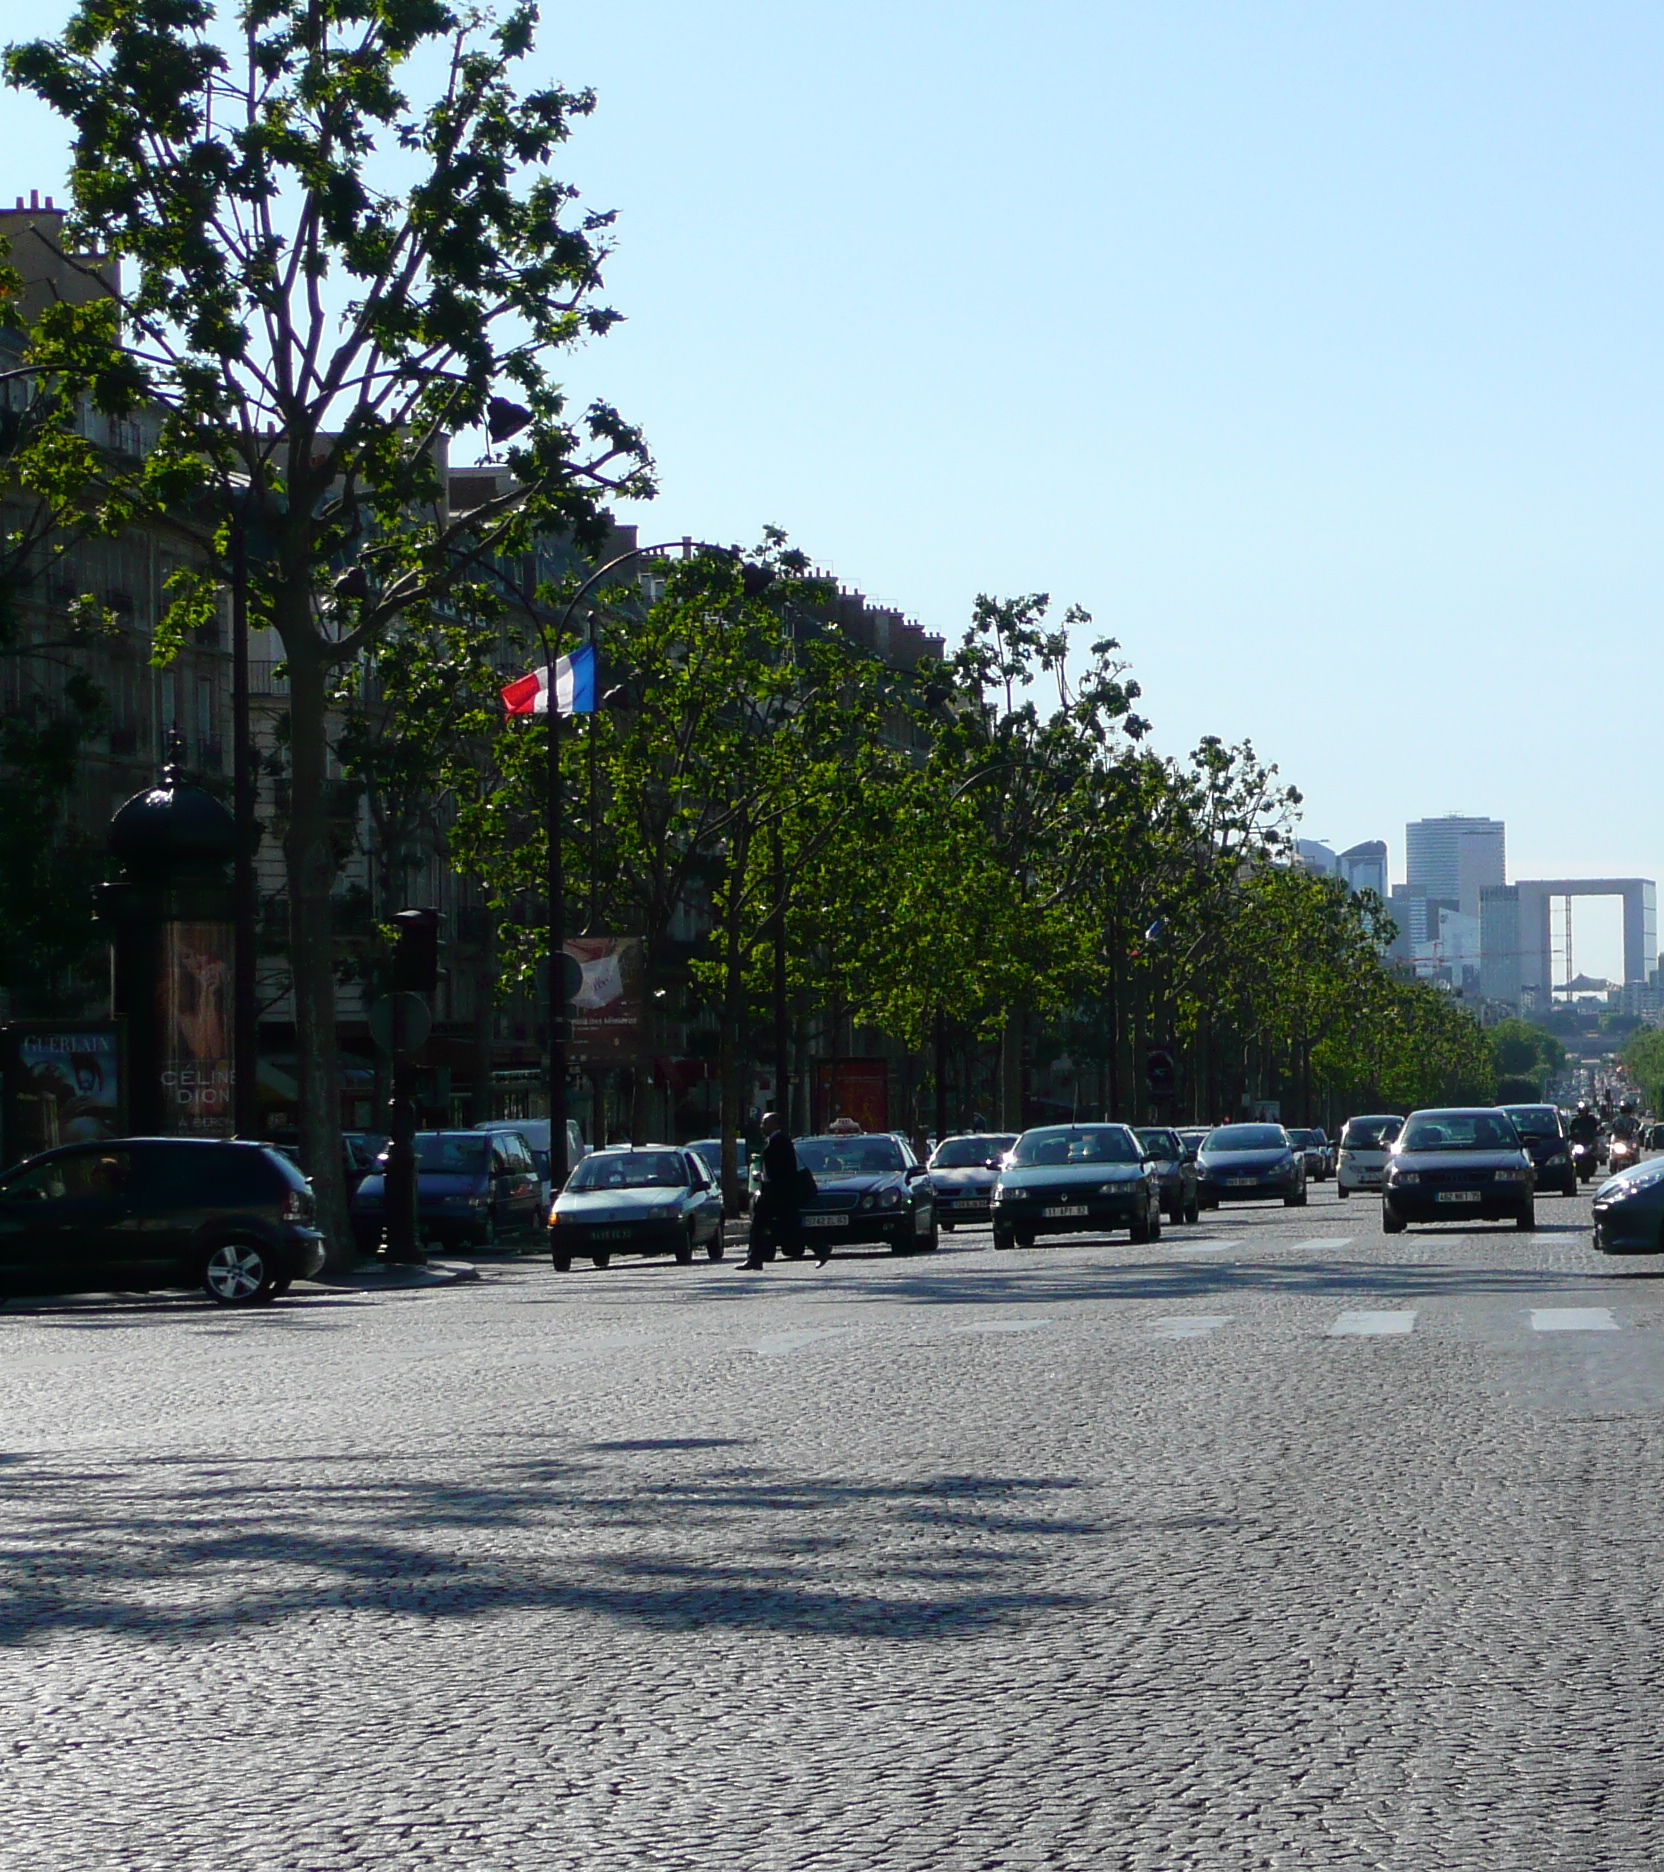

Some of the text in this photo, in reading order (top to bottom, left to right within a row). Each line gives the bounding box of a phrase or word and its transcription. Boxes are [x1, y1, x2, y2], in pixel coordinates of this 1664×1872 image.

[24, 1035, 111, 1053] GUERLAIN
[161, 1064, 236, 1086] CÉLINE
[178, 1088, 230, 1104] DION
